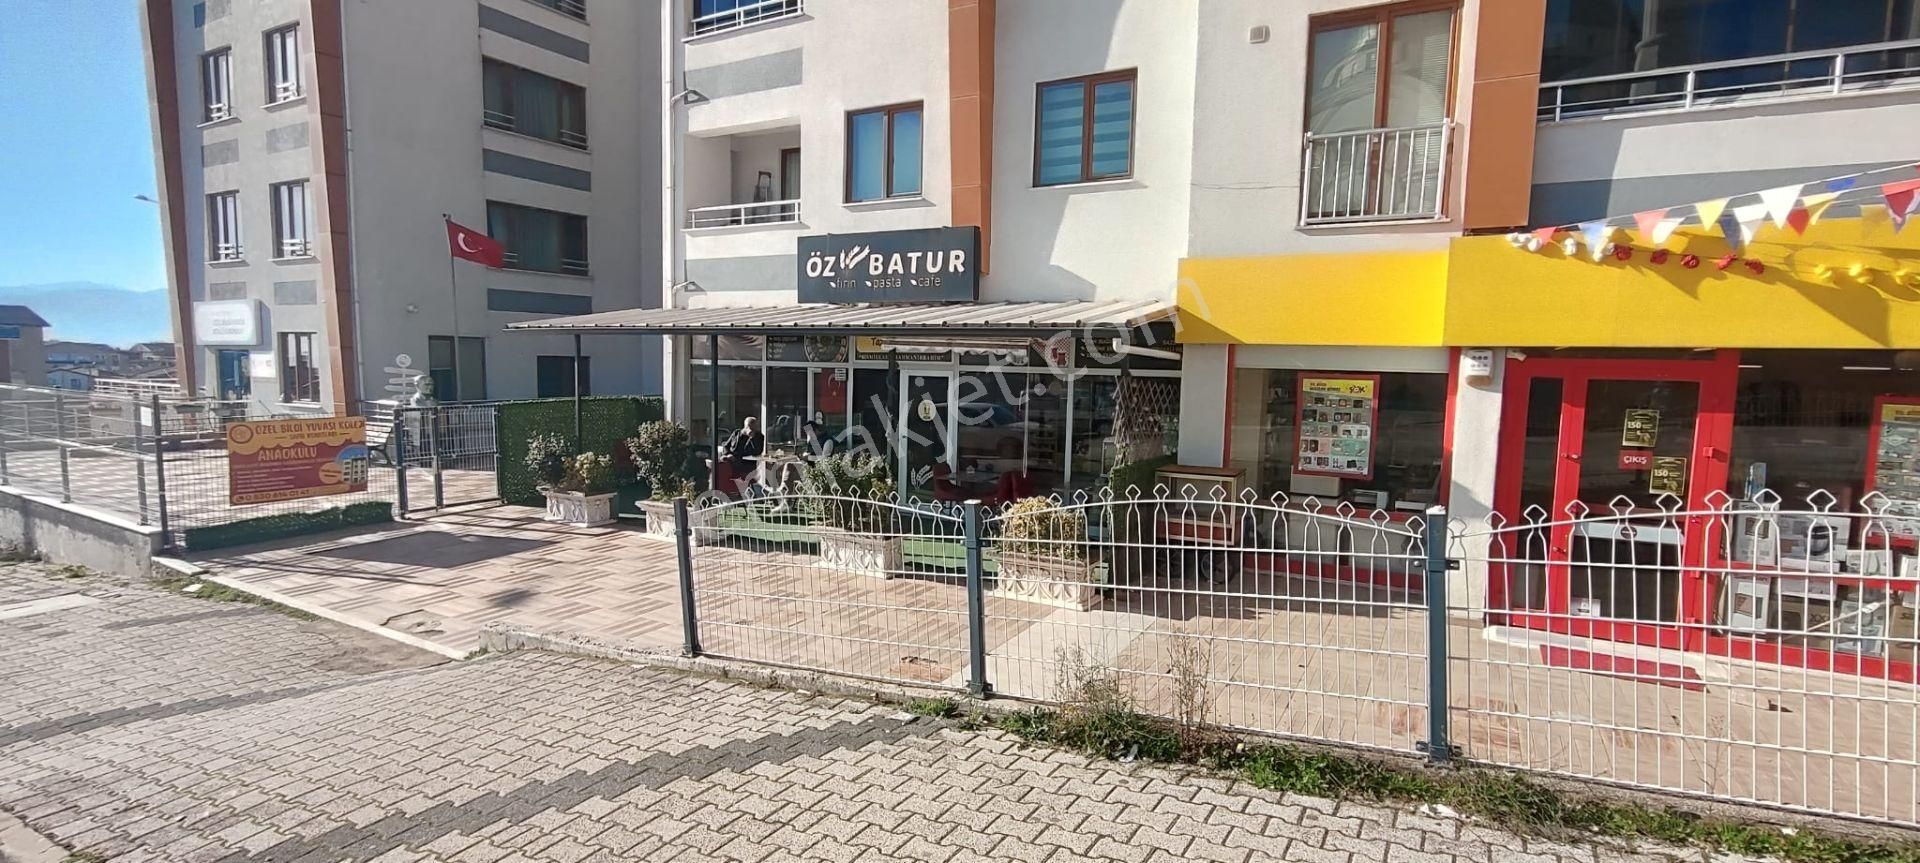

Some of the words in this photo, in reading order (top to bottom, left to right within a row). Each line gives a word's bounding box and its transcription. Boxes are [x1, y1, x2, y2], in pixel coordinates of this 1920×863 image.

[806, 251, 836, 278] ÖZ
[868, 249, 966, 276] BATUR
[873, 275, 902, 290] pasta
[918, 276, 942, 288] cafe
[1627, 421, 1642, 429] 150
[259, 447, 317, 461] ANAOKULU
[1623, 455, 1647, 465] ÇIKIŞ
[1654, 469, 1668, 477] 150
